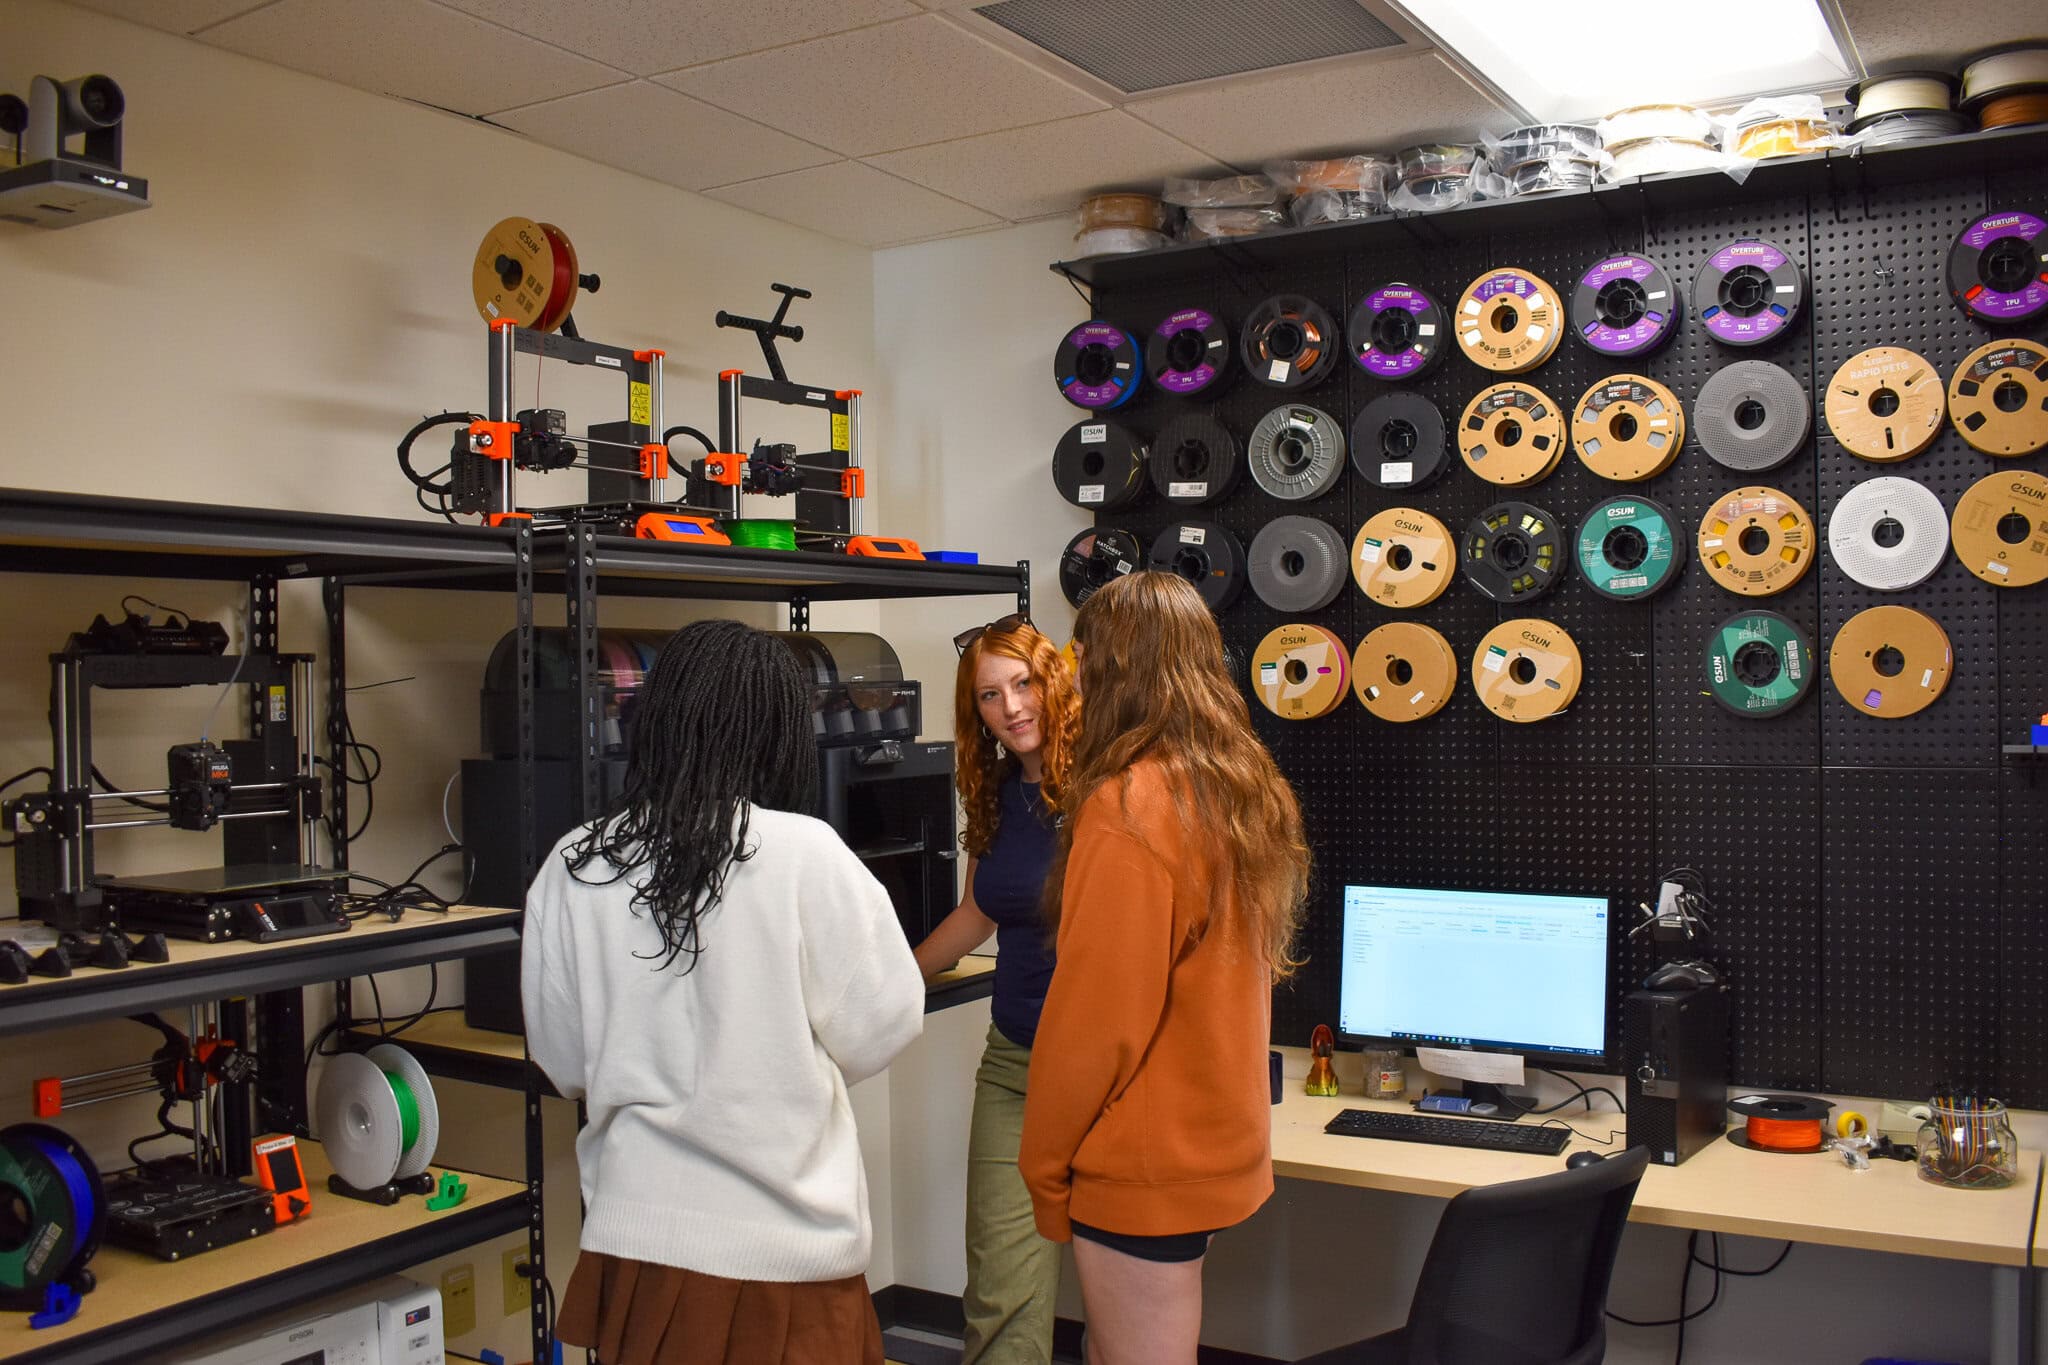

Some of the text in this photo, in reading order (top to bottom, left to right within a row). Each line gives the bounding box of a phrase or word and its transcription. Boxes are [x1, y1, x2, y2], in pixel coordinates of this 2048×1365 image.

[1982, 216, 2020, 228] OVERTURE
[1601, 260, 1633, 271] OVERTURE
[2005, 298, 2020, 306] TPU
[1172, 312, 1197, 323] OVERTURE
[1988, 350, 2015, 361] OVERTURE
[1850, 368, 1880, 379] RAPID
[2011, 483, 2047, 501] eSUN
[1607, 507, 1635, 517] eSUN
[1394, 519, 1423, 533] eSUN
[1280, 636, 1307, 645] eSUN
[1522, 630, 1551, 648] eSUN
[289, 1328, 314, 1342] EPSON
